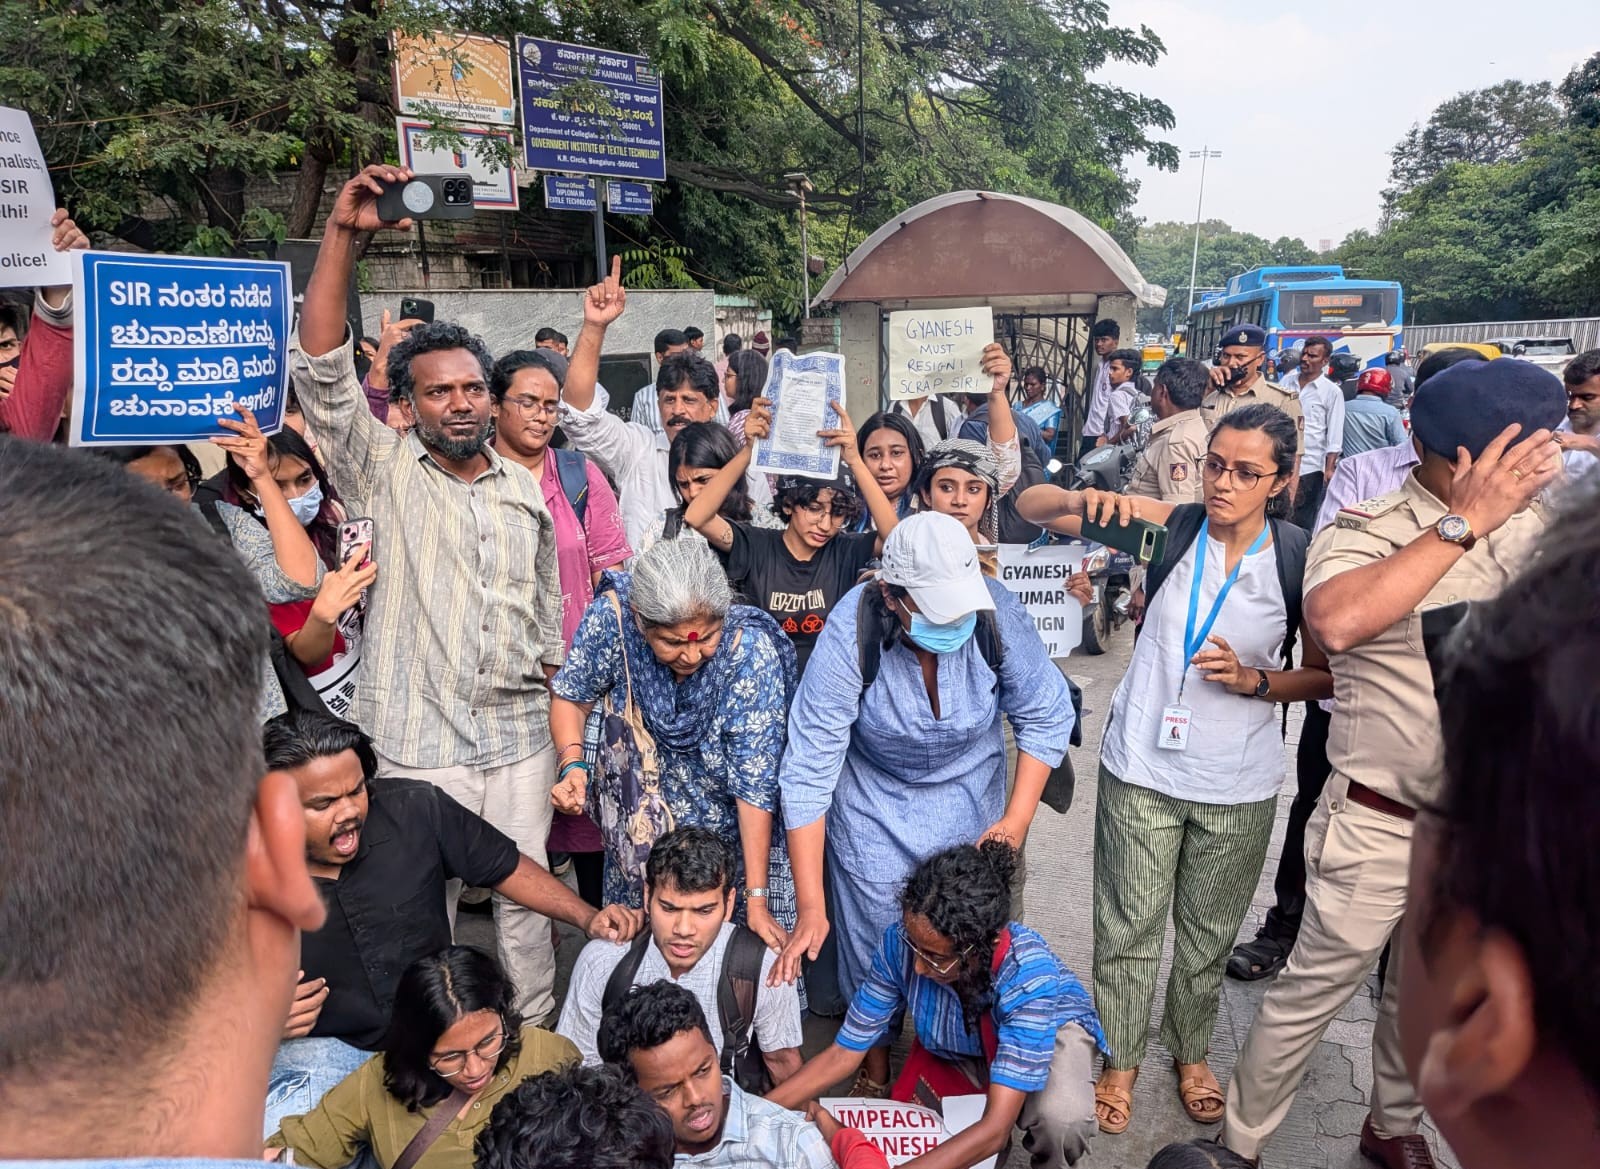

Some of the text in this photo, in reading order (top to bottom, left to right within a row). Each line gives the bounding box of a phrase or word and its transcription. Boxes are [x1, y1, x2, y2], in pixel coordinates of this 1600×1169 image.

[598, 56, 628, 68] ಸರ್ಕಾರ
[602, 70, 634, 82] KARNATAKA
[529, 125, 563, 135] Department
[636, 137, 660, 146] Education
[531, 137, 660, 160] GOVERNMENT INSTITUTE OF TEXTILE TECHNOLOGY
[588, 157, 616, 167] Bengaluru
[549, 196, 566, 204] EXTILE
[556, 188, 585, 198] DIPLOMA IN
[0, 204, 28, 219] lhi!
[110, 280, 272, 308] SIR ನಂತರ ನಡೆದ
[111, 318, 276, 350] ಚುನಾವಣೆಗಳನ್ನು
[905, 318, 975, 340] GYANESH
[919, 343, 956, 355] MUST
[111, 353, 277, 392] ರದ್ದು ಮಾಡಿ ಮರು
[898, 377, 943, 394] SCRAP
[110, 390, 235, 417] ಚುನಾವಣೆ
[1002, 564, 1073, 581] GYANESH
[1164, 715, 1189, 725] PRESS
[838, 1109, 936, 1129] IMPEACH
